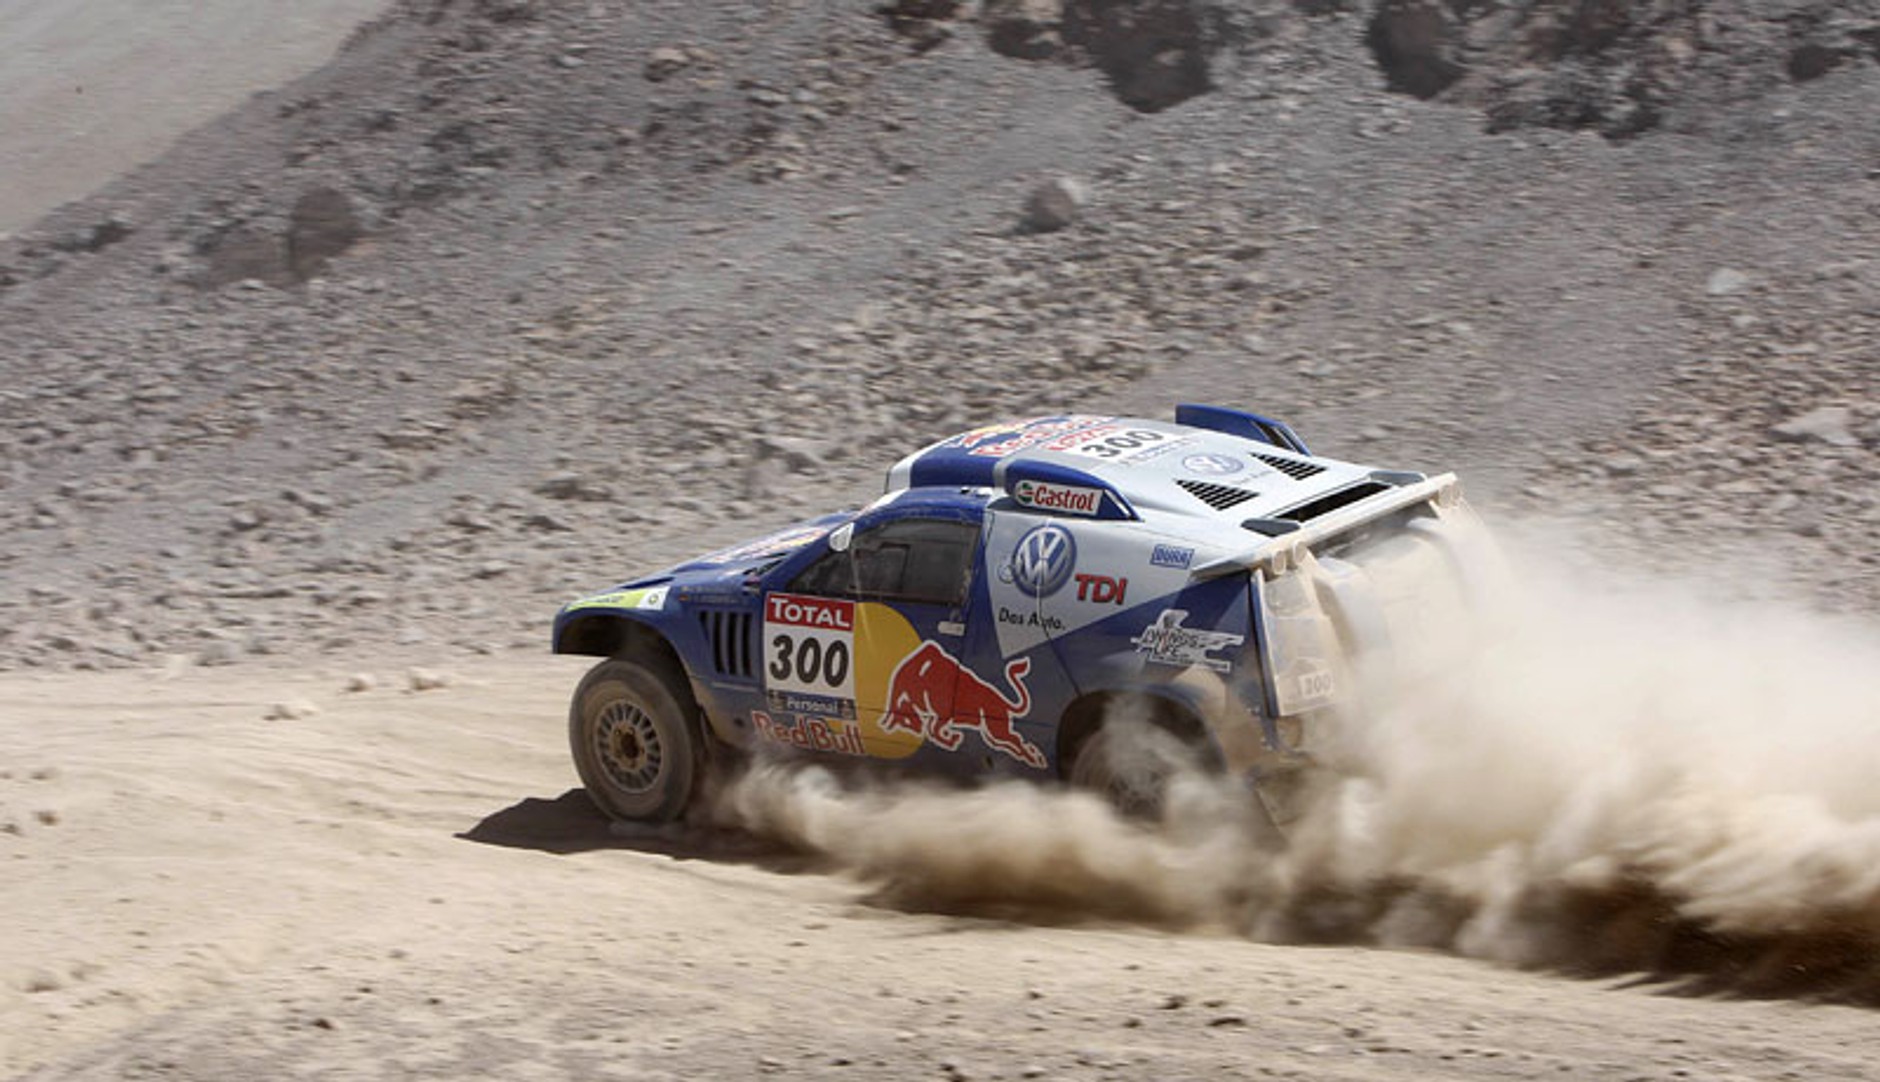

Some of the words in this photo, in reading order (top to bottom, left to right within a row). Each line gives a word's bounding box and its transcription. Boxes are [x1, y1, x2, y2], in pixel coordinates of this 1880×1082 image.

[1081, 430, 1164, 458] 300
[1034, 484, 1095, 512] Castrol
[1075, 572, 1128, 606] TDI
[770, 597, 850, 628] TOTAL
[998, 607, 1024, 626] Das
[769, 633, 849, 688] 300
[786, 696, 838, 712] Personal
